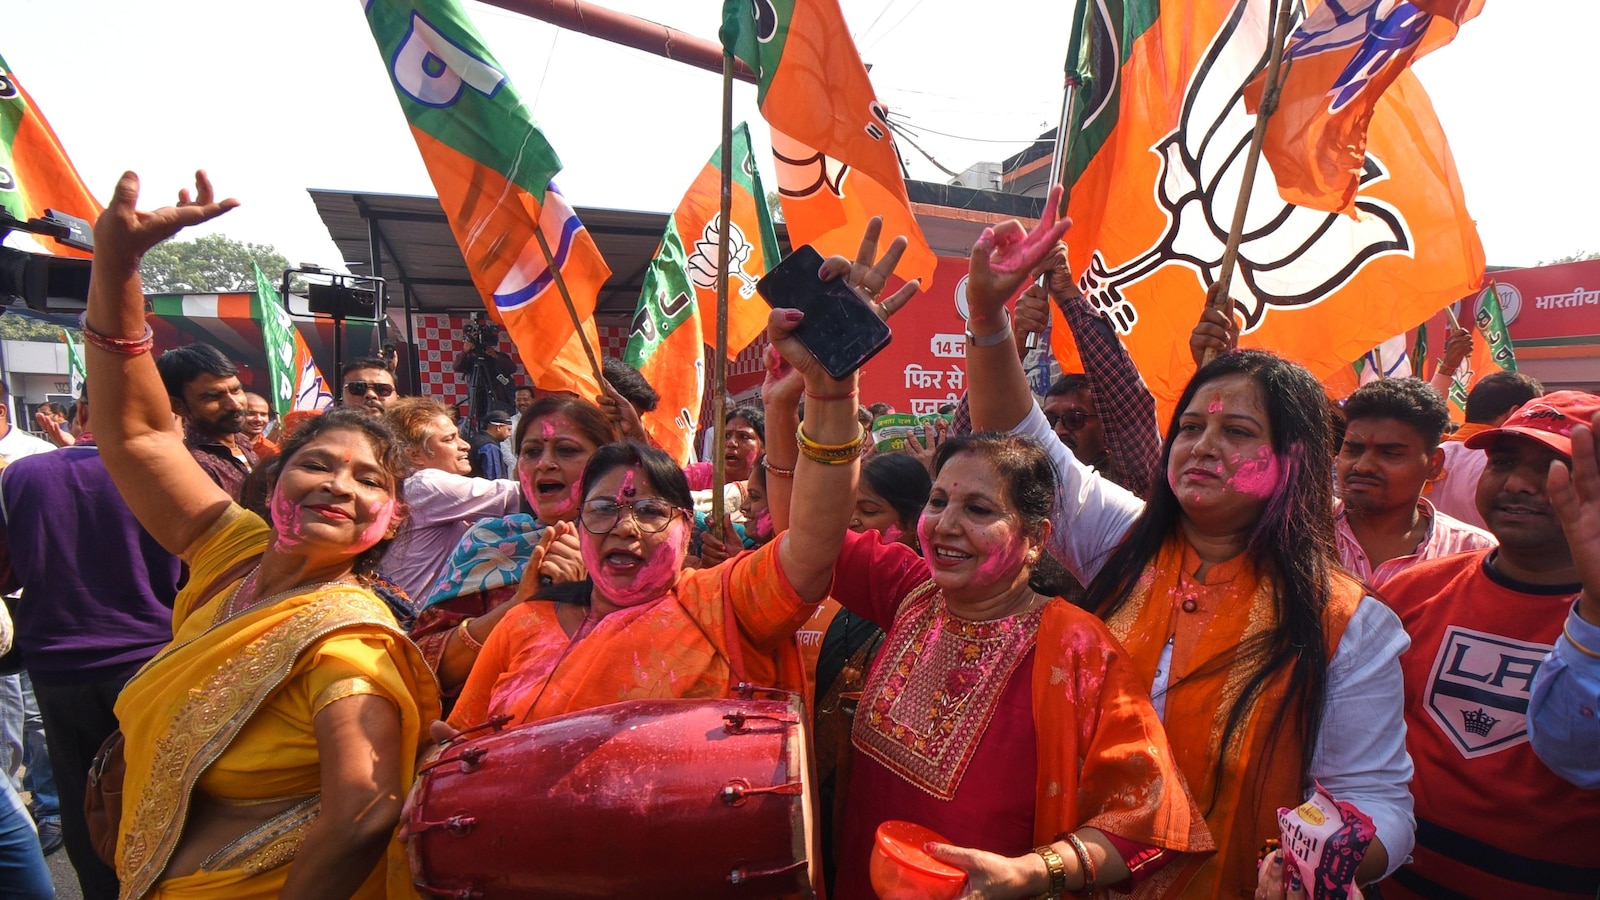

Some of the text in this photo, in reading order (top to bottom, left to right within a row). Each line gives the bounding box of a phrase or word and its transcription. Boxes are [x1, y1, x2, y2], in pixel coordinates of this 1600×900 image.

[1535, 287, 1600, 309] भारतीय
[936, 341, 951, 354] 14
[903, 363, 964, 389] फिर से
[1446, 644, 1541, 691] LA
[1278, 813, 1318, 853] erbal
